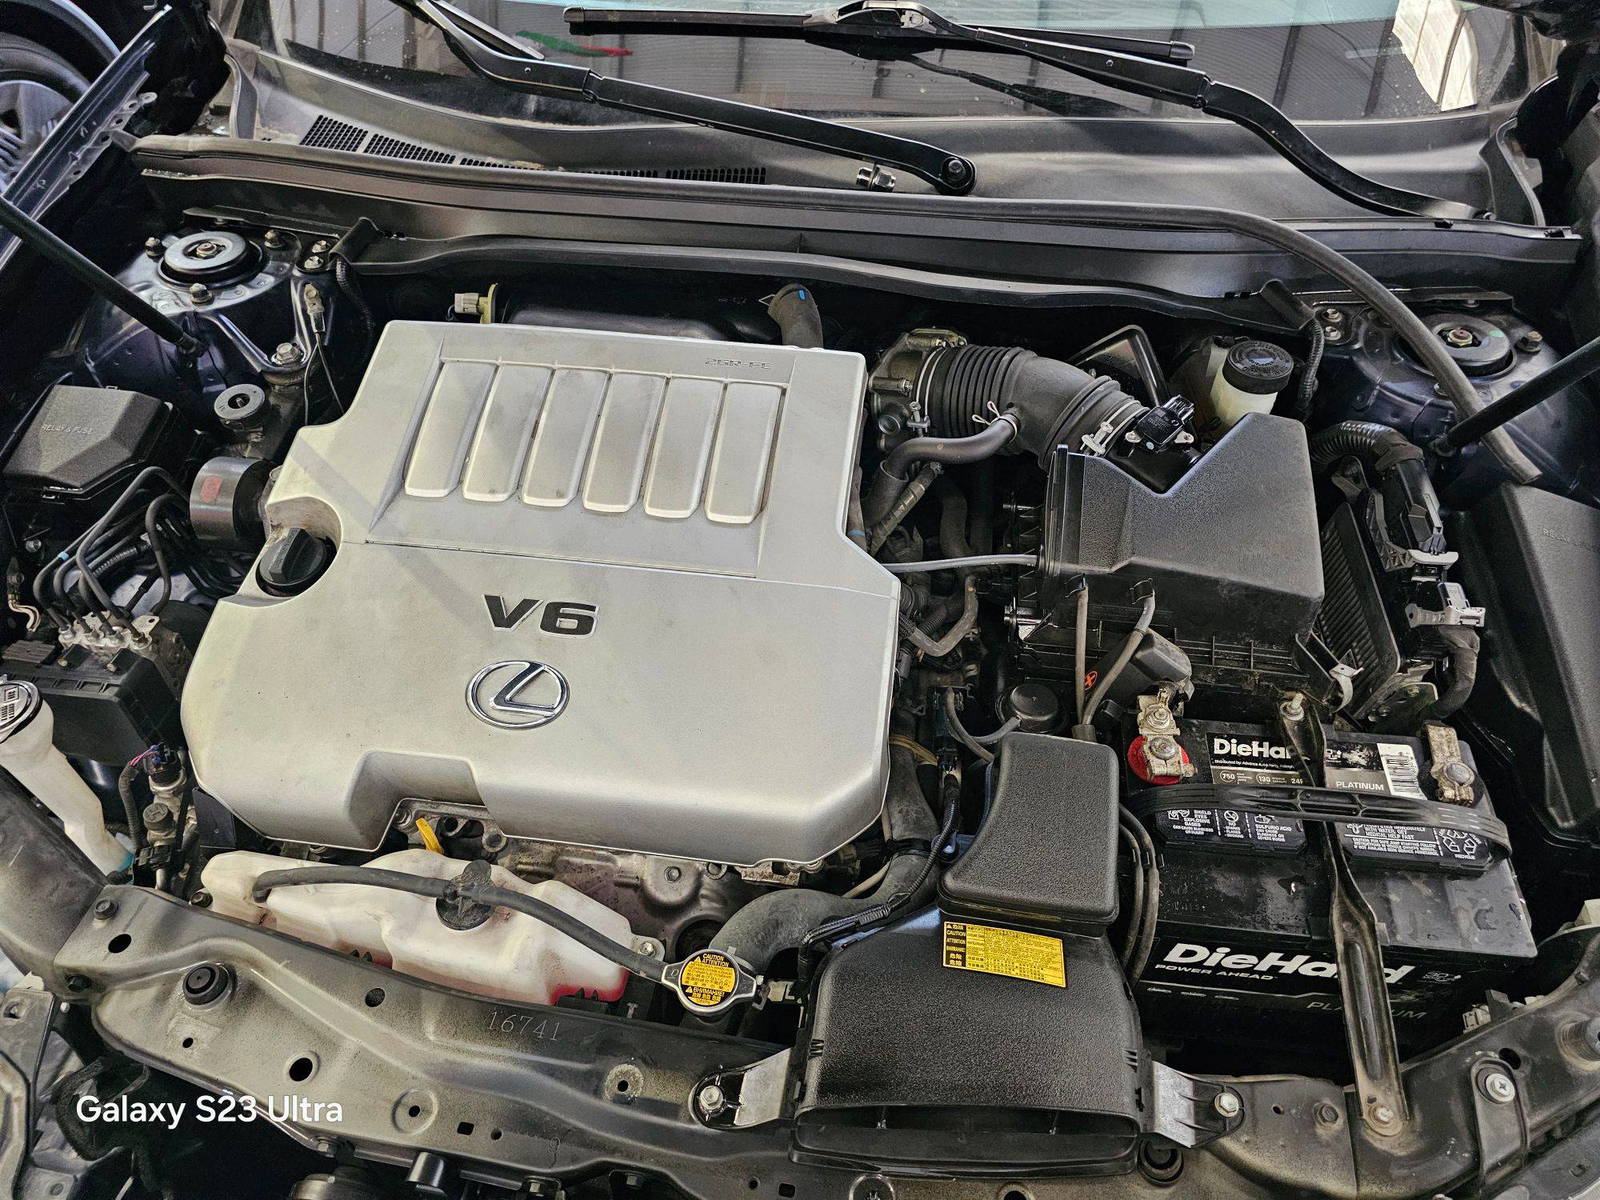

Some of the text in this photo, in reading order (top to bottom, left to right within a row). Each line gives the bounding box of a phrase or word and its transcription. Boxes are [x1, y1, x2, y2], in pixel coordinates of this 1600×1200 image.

[482, 594, 599, 640] V6
[1336, 781, 1384, 791] PLATINUM
[701, 958, 730, 968] ATTENTION
[702, 953, 725, 961] CAUTION
[1163, 942, 1415, 984] DieHad
[1154, 963, 1213, 975] POWER
[486, 1006, 562, 1042] 16741
